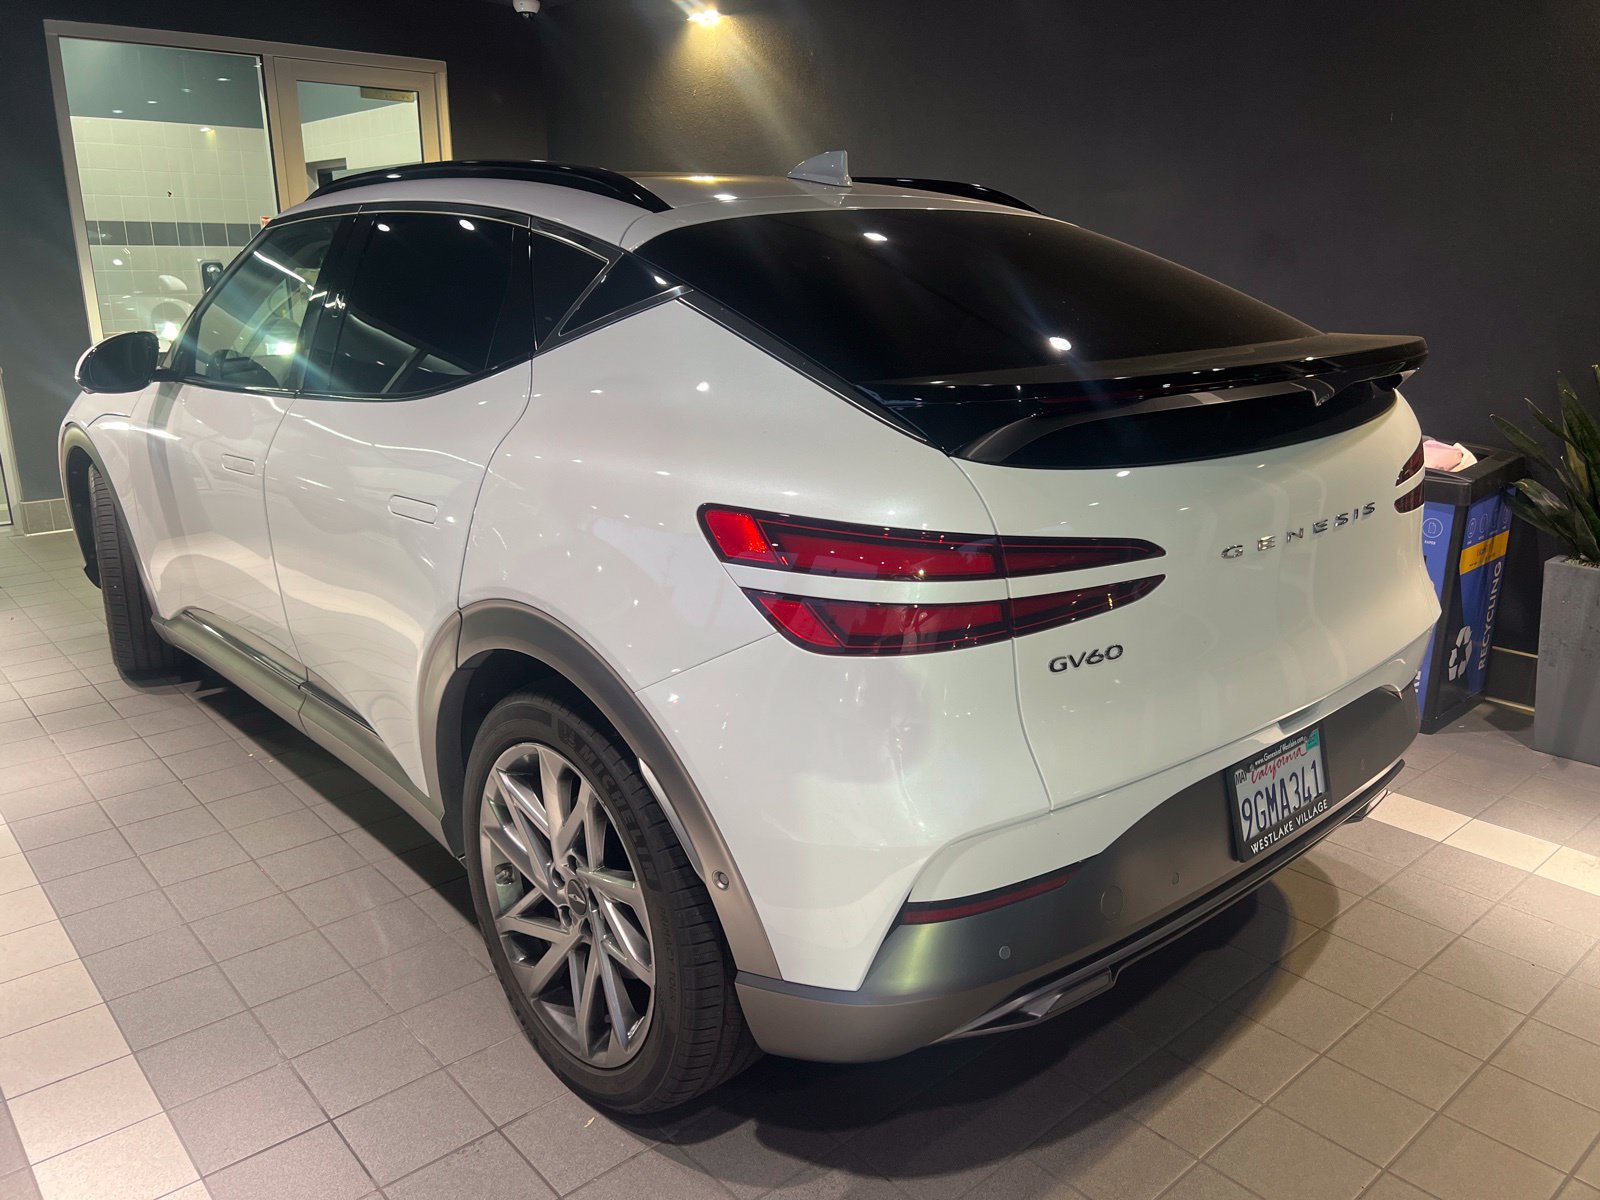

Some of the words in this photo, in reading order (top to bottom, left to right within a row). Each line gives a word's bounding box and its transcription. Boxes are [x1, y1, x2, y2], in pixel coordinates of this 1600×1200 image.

[1221, 502, 1375, 559] GENESIS
[1477, 561, 1502, 671] RECYCLING
[1049, 644, 1124, 673] GV60
[1251, 747, 1308, 784] California
[578, 741, 660, 883] MICHELIN
[1241, 760, 1323, 843] 9GMA341
[1250, 821, 1294, 855] WESTLAKE
[1296, 798, 1328, 827] VILLAGE
